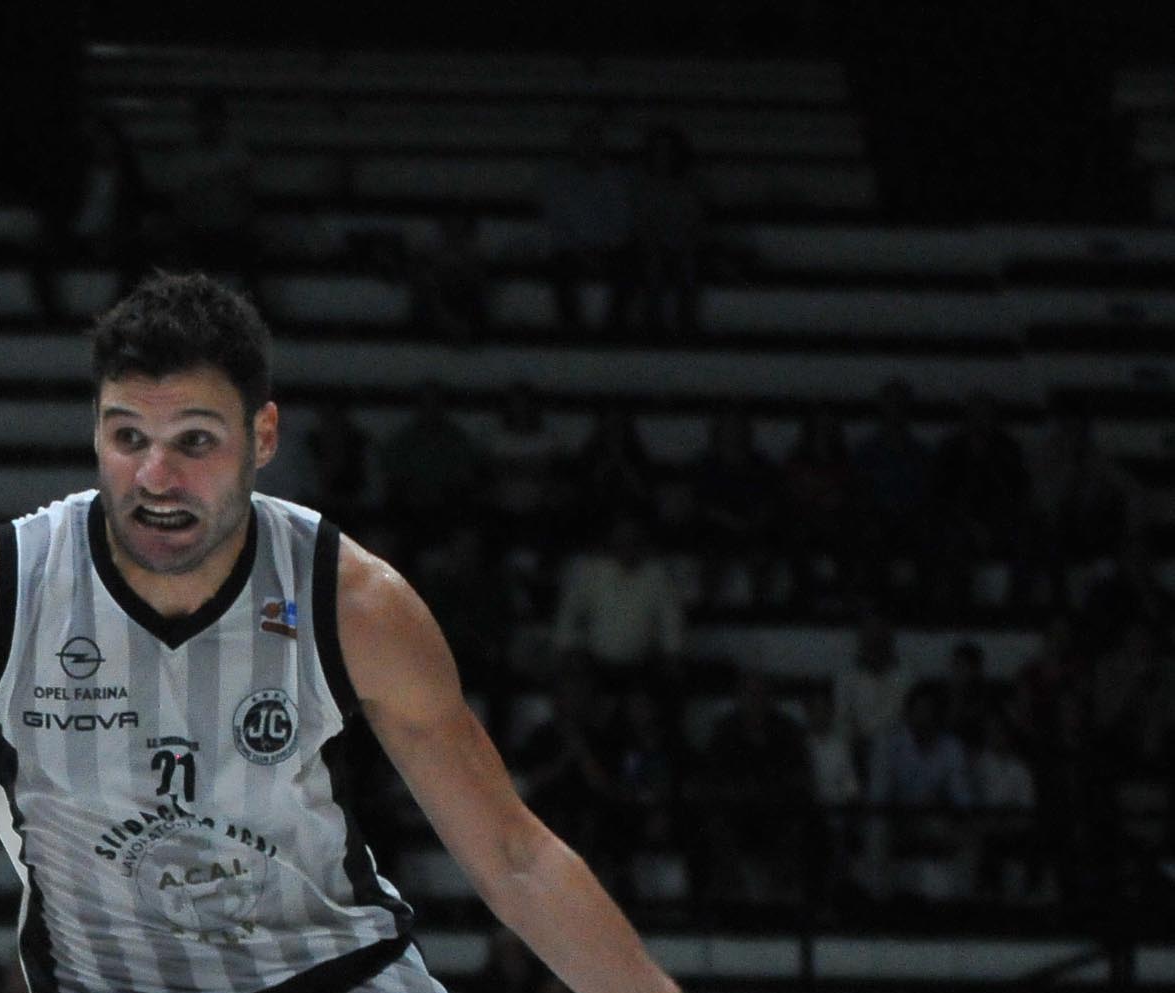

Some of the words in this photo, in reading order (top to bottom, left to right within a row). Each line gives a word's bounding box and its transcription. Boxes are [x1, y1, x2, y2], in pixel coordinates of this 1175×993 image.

[33, 686, 70, 700] OPEL
[74, 686, 128, 700] FARINA
[22, 711, 139, 731] GIVOVA
